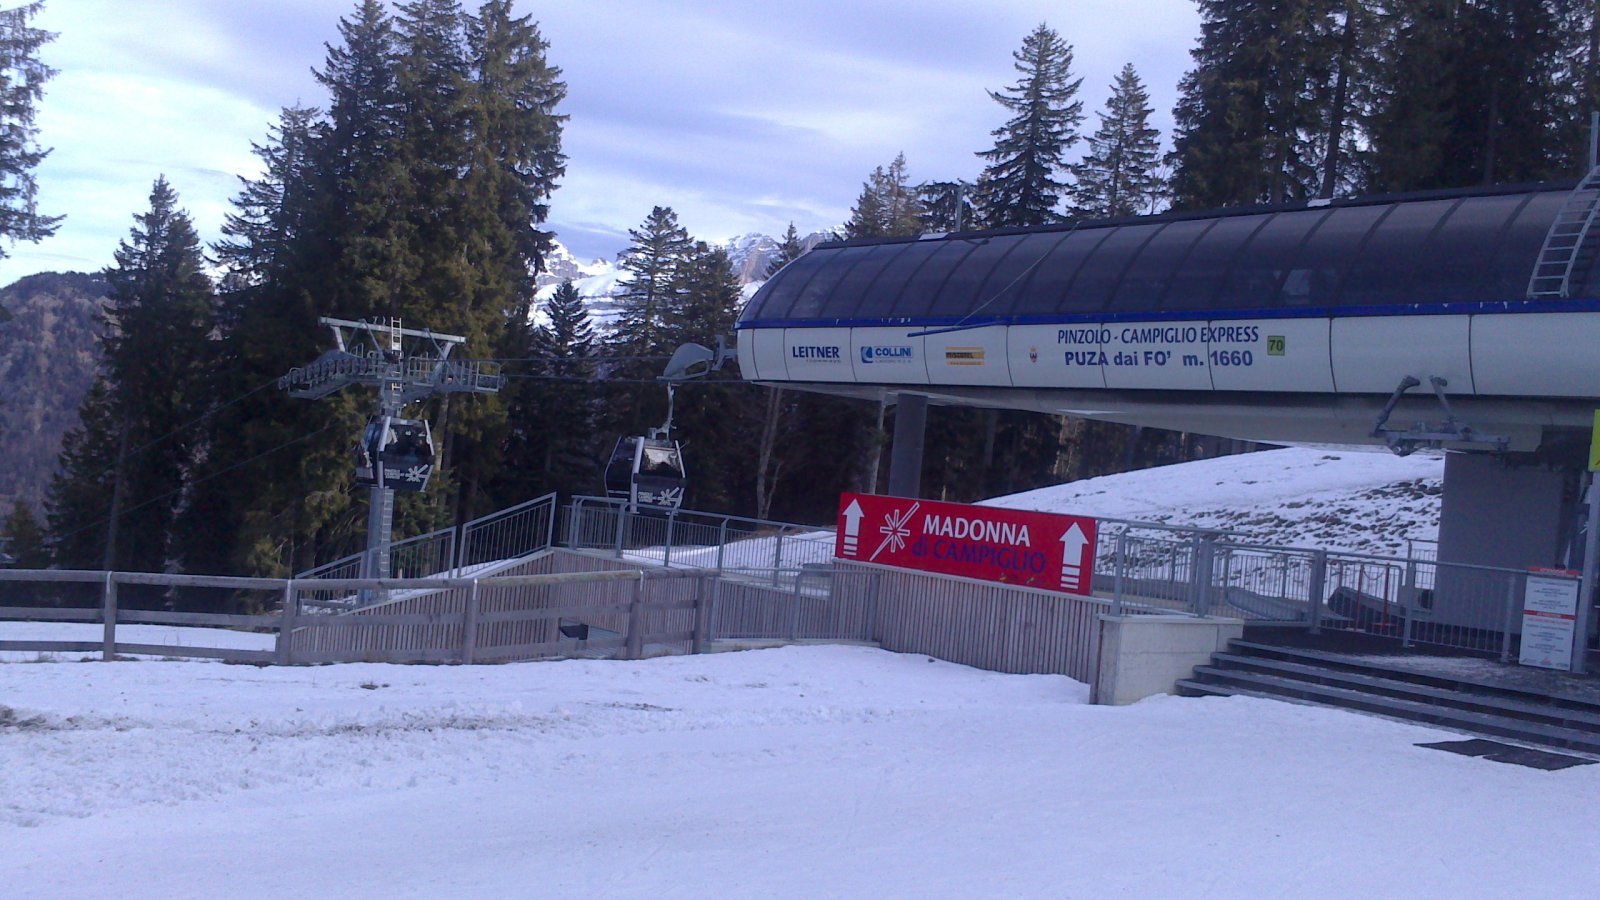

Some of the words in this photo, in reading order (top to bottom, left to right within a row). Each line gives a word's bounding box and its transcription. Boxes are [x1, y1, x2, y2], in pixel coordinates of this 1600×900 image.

[1058, 329, 1111, 344] PINZOLO
[1121, 328, 1197, 343] CAMPIGLIO
[1200, 326, 1259, 342] EXPRESS
[793, 346, 839, 358] LEITNER
[875, 347, 912, 357] COLLINI
[1269, 340, 1283, 352] 70
[1065, 352, 1109, 366] PUZA
[1114, 351, 1138, 366] dai
[1182, 355, 1204, 366] m.
[1211, 350, 1253, 366] 1660
[922, 514, 1031, 547] MADONNA
[912, 540, 928, 557] di
[933, 541, 1047, 573] CAMPIGLIO
